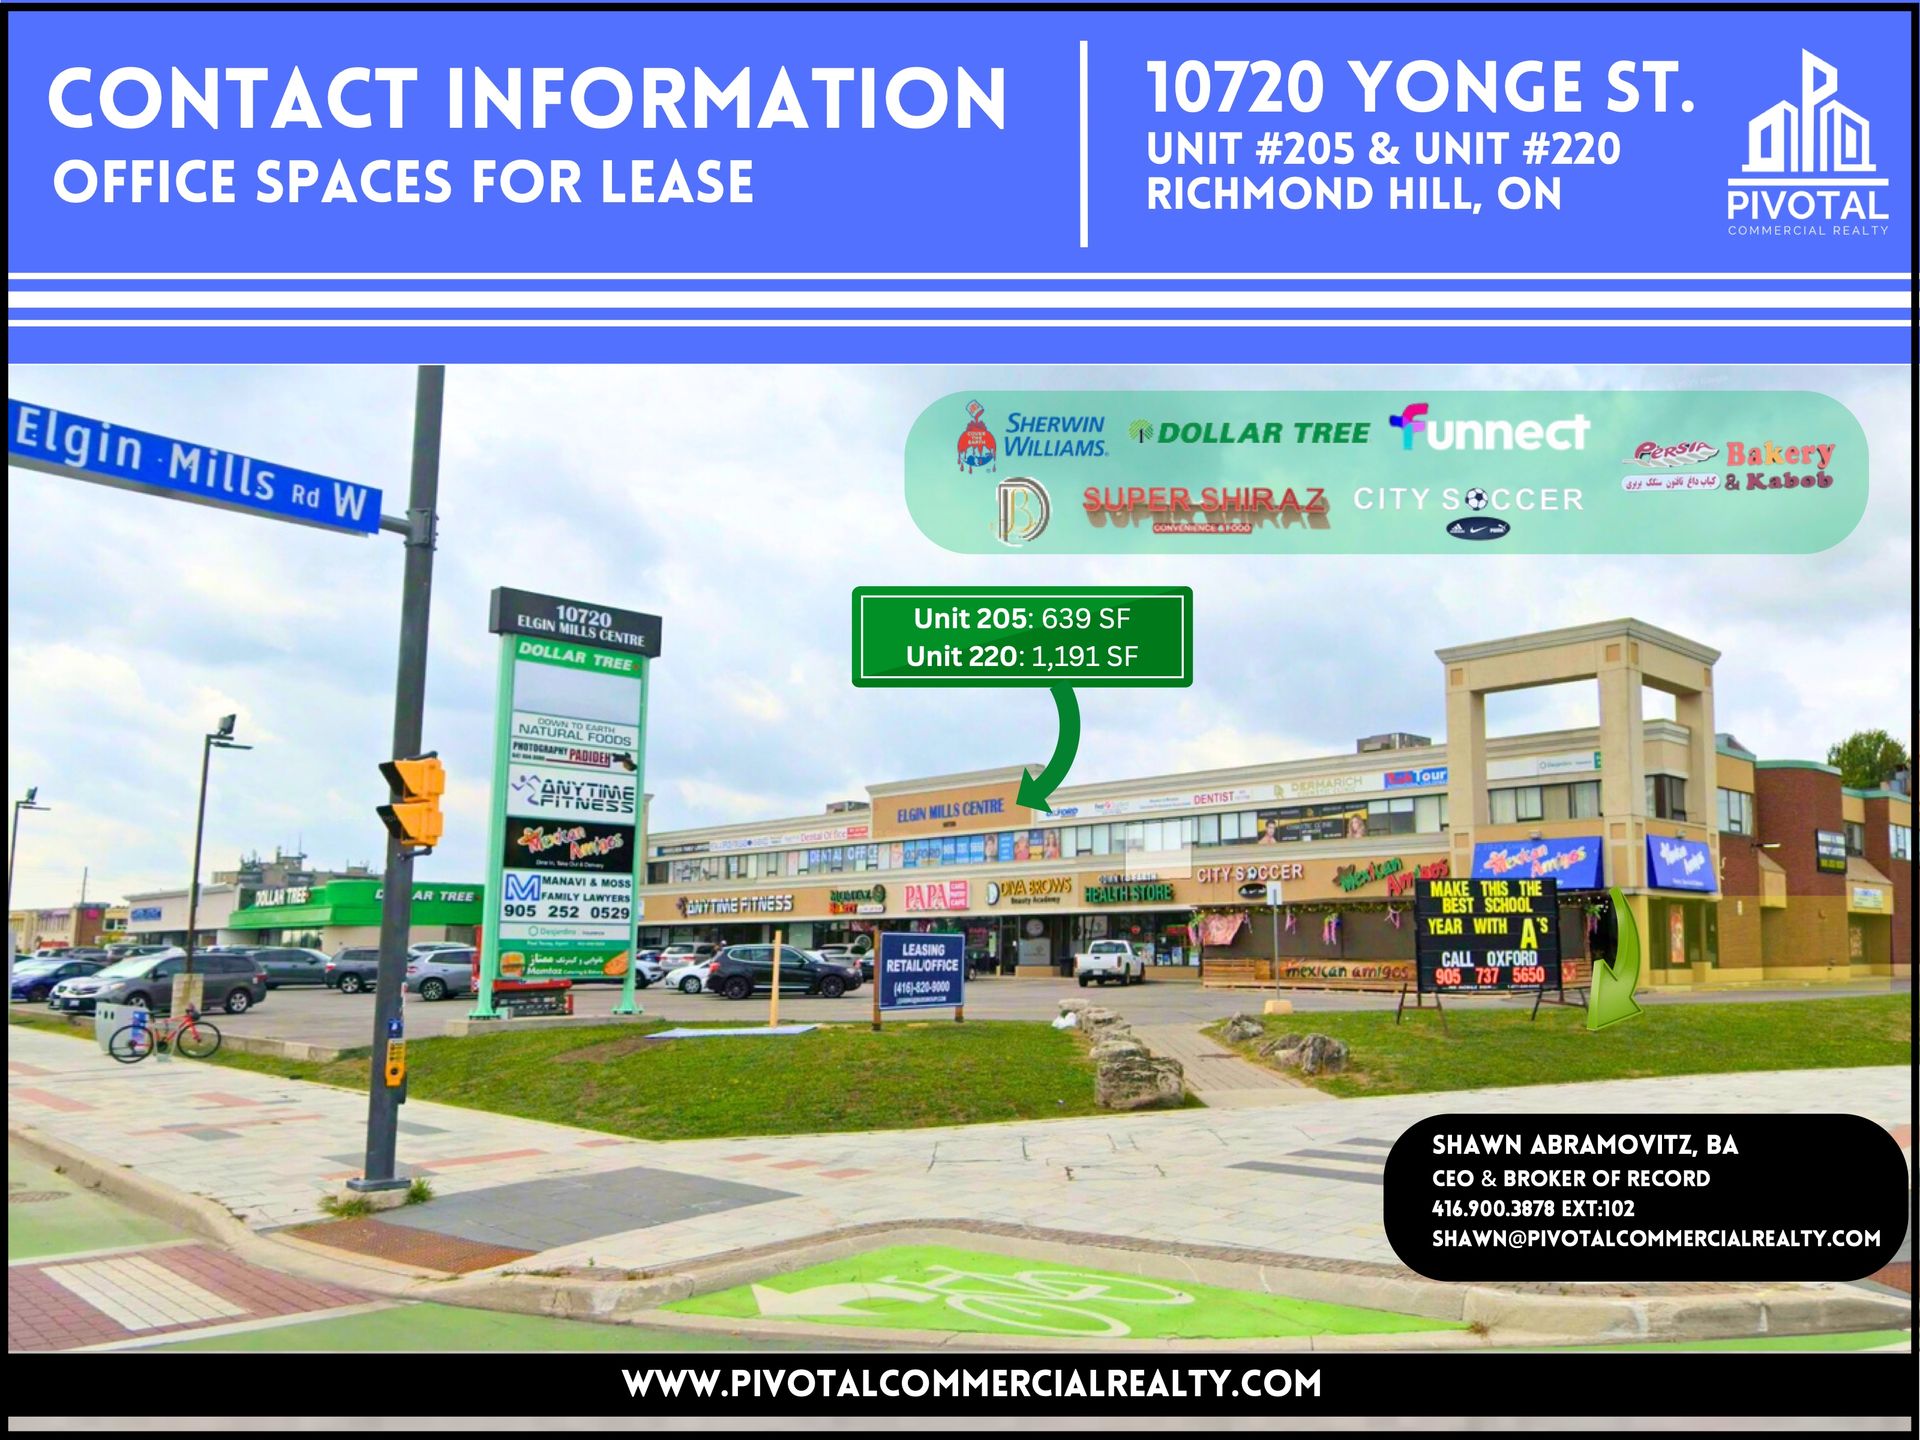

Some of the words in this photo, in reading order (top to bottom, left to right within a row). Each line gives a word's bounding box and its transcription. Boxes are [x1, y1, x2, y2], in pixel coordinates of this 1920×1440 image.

[16, 406, 141, 468] Elgin
[169, 443, 275, 500] Mills
[291, 484, 319, 508] Rd
[333, 482, 367, 521] W
[556, 605, 612, 628] 10720
[517, 614, 556, 632] ELGIN
[559, 621, 597, 639] MILLS
[600, 629, 646, 648] CENTRE
[518, 641, 586, 664] DOLLAR
[593, 654, 633, 671] TREE
[538, 718, 568, 729] DOWN
[572, 721, 583, 731] TO
[586, 724, 615, 734] EARTH
[519, 724, 584, 741] NATURAL
[588, 733, 632, 747] FOODS
[513, 741, 569, 755] PHOTOGRAPHY
[541, 779, 635, 800] ANYTIME
[1194, 791, 1234, 805] DENTIST
[540, 795, 634, 814] FITNESS
[897, 808, 926, 823] ELGIN
[929, 802, 960, 819] MILLS
[962, 797, 1004, 817] CENTRE
[519, 826, 586, 853] Mexican
[570, 833, 624, 860] Amigos
[542, 876, 586, 886] MANAVI
[590, 877, 597, 886] &
[601, 879, 631, 888] MOSS
[1197, 867, 1232, 883] CITY
[504, 874, 541, 901] M
[1001, 880, 1027, 896] DIVA
[1029, 877, 1072, 895] BROWS
[1084, 886, 1129, 903] HEALTH
[1130, 883, 1173, 901] STORE
[1430, 880, 1469, 897] MAKE
[1480, 880, 1508, 897] THIS
[1519, 880, 1543, 896] THE
[255, 890, 285, 907] DOLLAR
[286, 887, 306, 904] TREE
[440, 891, 474, 902] TREE
[542, 892, 581, 901] FAMILY
[583, 893, 631, 903] LAWYERS
[740, 895, 793, 912] FITNESS
[905, 883, 948, 909] PAPA
[504, 904, 536, 917] 905
[548, 905, 579, 918] 252
[591, 907, 630, 919] 0529
[1442, 897, 1474, 914] BEST
[1485, 897, 1533, 912] SCHOOL
[1428, 918, 1463, 935] YEAR
[1473, 918, 1508, 934] WITH
[902, 943, 945, 956] LEASING
[887, 959, 959, 972] RETAIL/OFFICE
[1442, 951, 1474, 967] CALL
[1486, 950, 1538, 966] OXFORD
[1286, 965, 1347, 979] mexican
[1352, 965, 1409, 980] amigos
[1435, 969, 1461, 984] 905
[1475, 968, 1499, 984] 737
[1512, 967, 1545, 983] 5650
